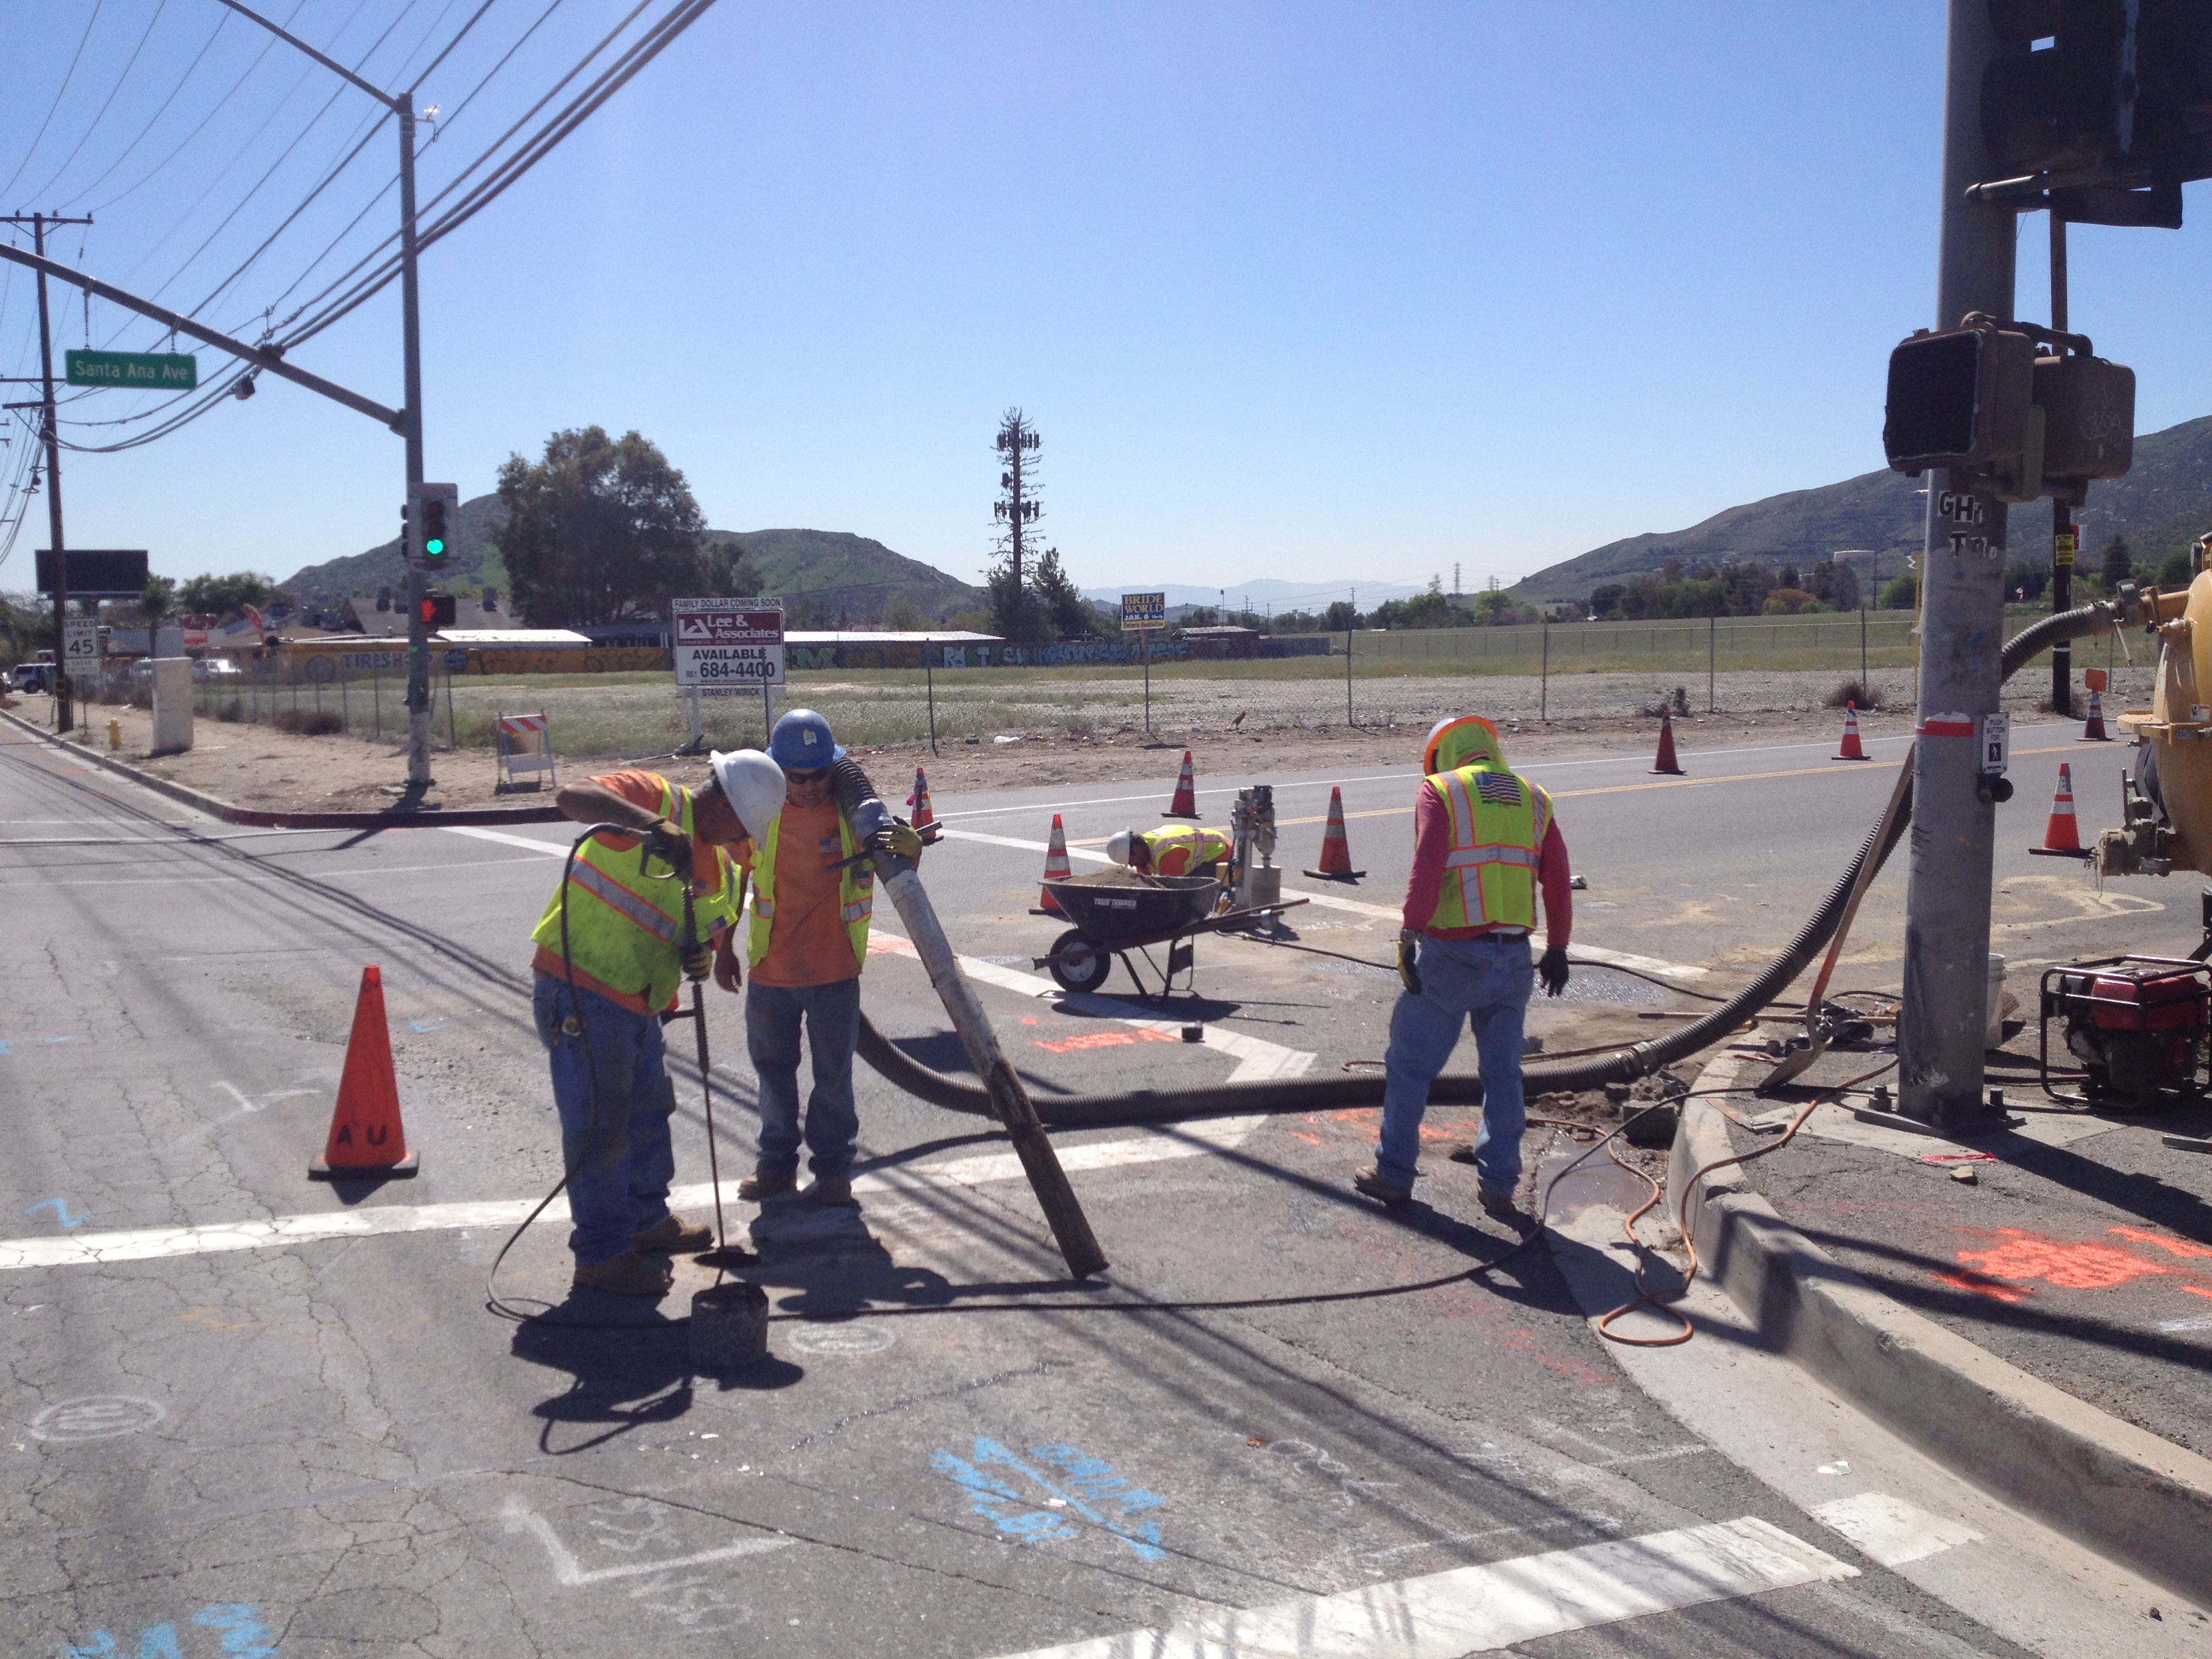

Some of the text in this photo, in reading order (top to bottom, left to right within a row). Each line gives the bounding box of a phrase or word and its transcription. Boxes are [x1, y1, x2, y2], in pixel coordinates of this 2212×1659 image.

[75, 360, 188, 381] Santa Ana Ave
[701, 599, 729, 607] DOLLAR
[730, 598, 759, 607] COMING
[760, 598, 781, 607] SOON
[1125, 595, 1162, 604] BRIDE
[1124, 604, 1163, 613] WORLD
[707, 614, 749, 628] Lee &
[715, 628, 780, 639] Associates
[69, 639, 94, 655] 45
[693, 649, 767, 660] AVAILABLE
[700, 661, 775, 678] 684-4400
[702, 688, 732, 697] STANLEY
